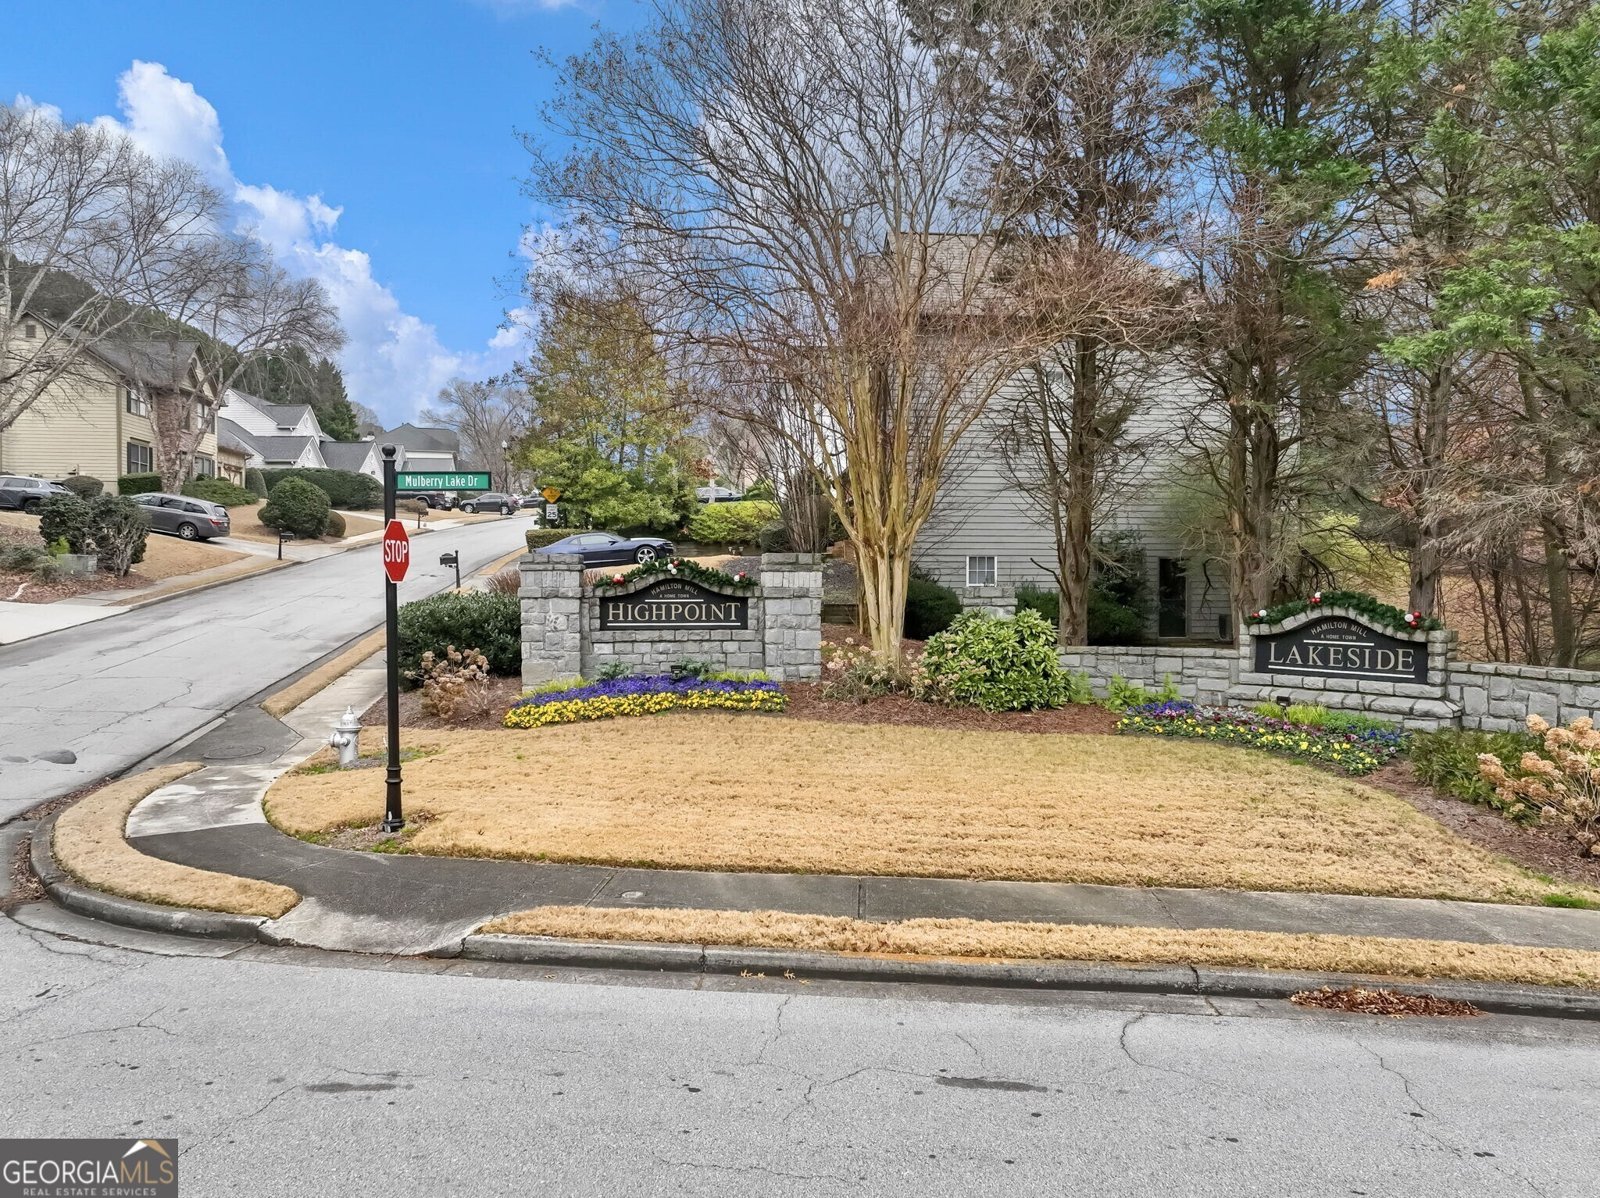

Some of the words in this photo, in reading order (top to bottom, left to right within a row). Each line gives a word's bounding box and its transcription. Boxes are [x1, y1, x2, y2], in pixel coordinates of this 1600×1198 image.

[405, 475, 443, 488] Mulberry
[445, 475, 466, 486] Lake
[468, 475, 478, 486] Dr
[384, 539, 408, 563] STOP
[650, 583, 682, 596] HAMILTON
[684, 584, 699, 596] MILL
[607, 602, 741, 621] HIGHPOINT
[1310, 621, 1348, 636] HAMILTON
[1350, 624, 1368, 638] MILL
[1269, 642, 1415, 672] LAKESIDE
